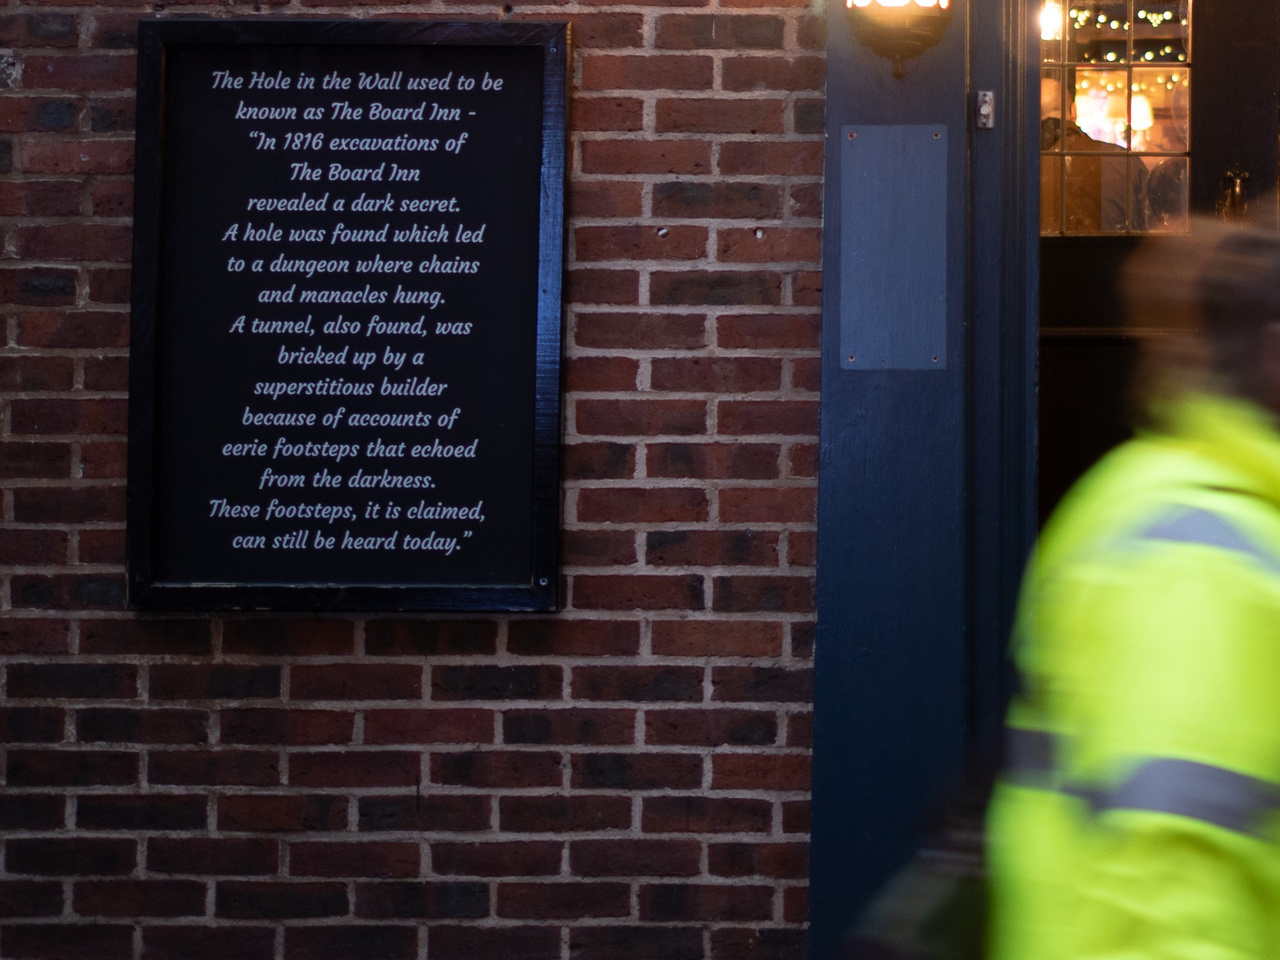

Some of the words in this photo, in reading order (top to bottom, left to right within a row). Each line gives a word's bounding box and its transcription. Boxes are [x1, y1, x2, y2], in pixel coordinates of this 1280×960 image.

[211, 70, 244, 90] The
[248, 70, 292, 90] Hole
[296, 71, 316, 90] in
[322, 71, 352, 90] the
[358, 71, 403, 90] Wall
[406, 71, 453, 91] used
[457, 75, 476, 91] to
[481, 71, 504, 91] be
[234, 100, 298, 120] known
[303, 107, 325, 120] as
[331, 100, 363, 121] The
[368, 101, 426, 121] Board
[428, 102, 461, 121] Inn
[283, 132, 325, 151] 1816
[329, 133, 440, 152] excavations
[444, 131, 469, 155] of
[290, 161, 323, 181] The
[328, 162, 386, 182] Board
[388, 163, 421, 182] Inn
[246, 192, 329, 212] revealed
[332, 198, 346, 212] a
[350, 192, 395, 212] dark
[399, 196, 461, 213] secret.
[221, 223, 239, 242] A
[242, 222, 283, 242] hole
[288, 229, 327, 242] was
[330, 222, 390, 245] found
[393, 223, 449, 243] which
[455, 223, 487, 243] led
[227, 256, 246, 272] to
[251, 259, 264, 273] a
[269, 253, 350, 278] dungeon
[355, 254, 414, 274] where
[418, 254, 481, 274] chains
[257, 284, 296, 303] and
[299, 284, 389, 304] manacles
[392, 284, 446, 310] hung.
[228, 315, 246, 334] A
[251, 314, 315, 337] tunnel,
[322, 315, 361, 335] also
[365, 315, 427, 338] found,
[435, 321, 473, 335] was
[277, 345, 349, 365] bricked
[352, 352, 377, 371] up
[382, 345, 407, 371] by
[411, 352, 425, 366] a
[253, 377, 375, 401] superstitious
[380, 377, 448, 397] builder
[242, 406, 317, 426] because
[322, 406, 346, 429] of
[347, 411, 432, 427] accounts
[437, 407, 462, 430] of
[221, 438, 268, 457] eerie
[272, 436, 361, 463] footsteps
[366, 437, 407, 458] that
[410, 438, 479, 458] echoed
[258, 467, 306, 490] from
[312, 468, 343, 488] the
[347, 468, 436, 489] darkness.
[209, 498, 261, 518] These
[265, 498, 357, 525] footsteps,
[364, 501, 381, 519] it
[385, 501, 402, 519] is
[406, 499, 486, 523] claimed,
[232, 535, 266, 549] can
[271, 529, 310, 549] still
[313, 530, 336, 550] be
[340, 530, 399, 550] heard
